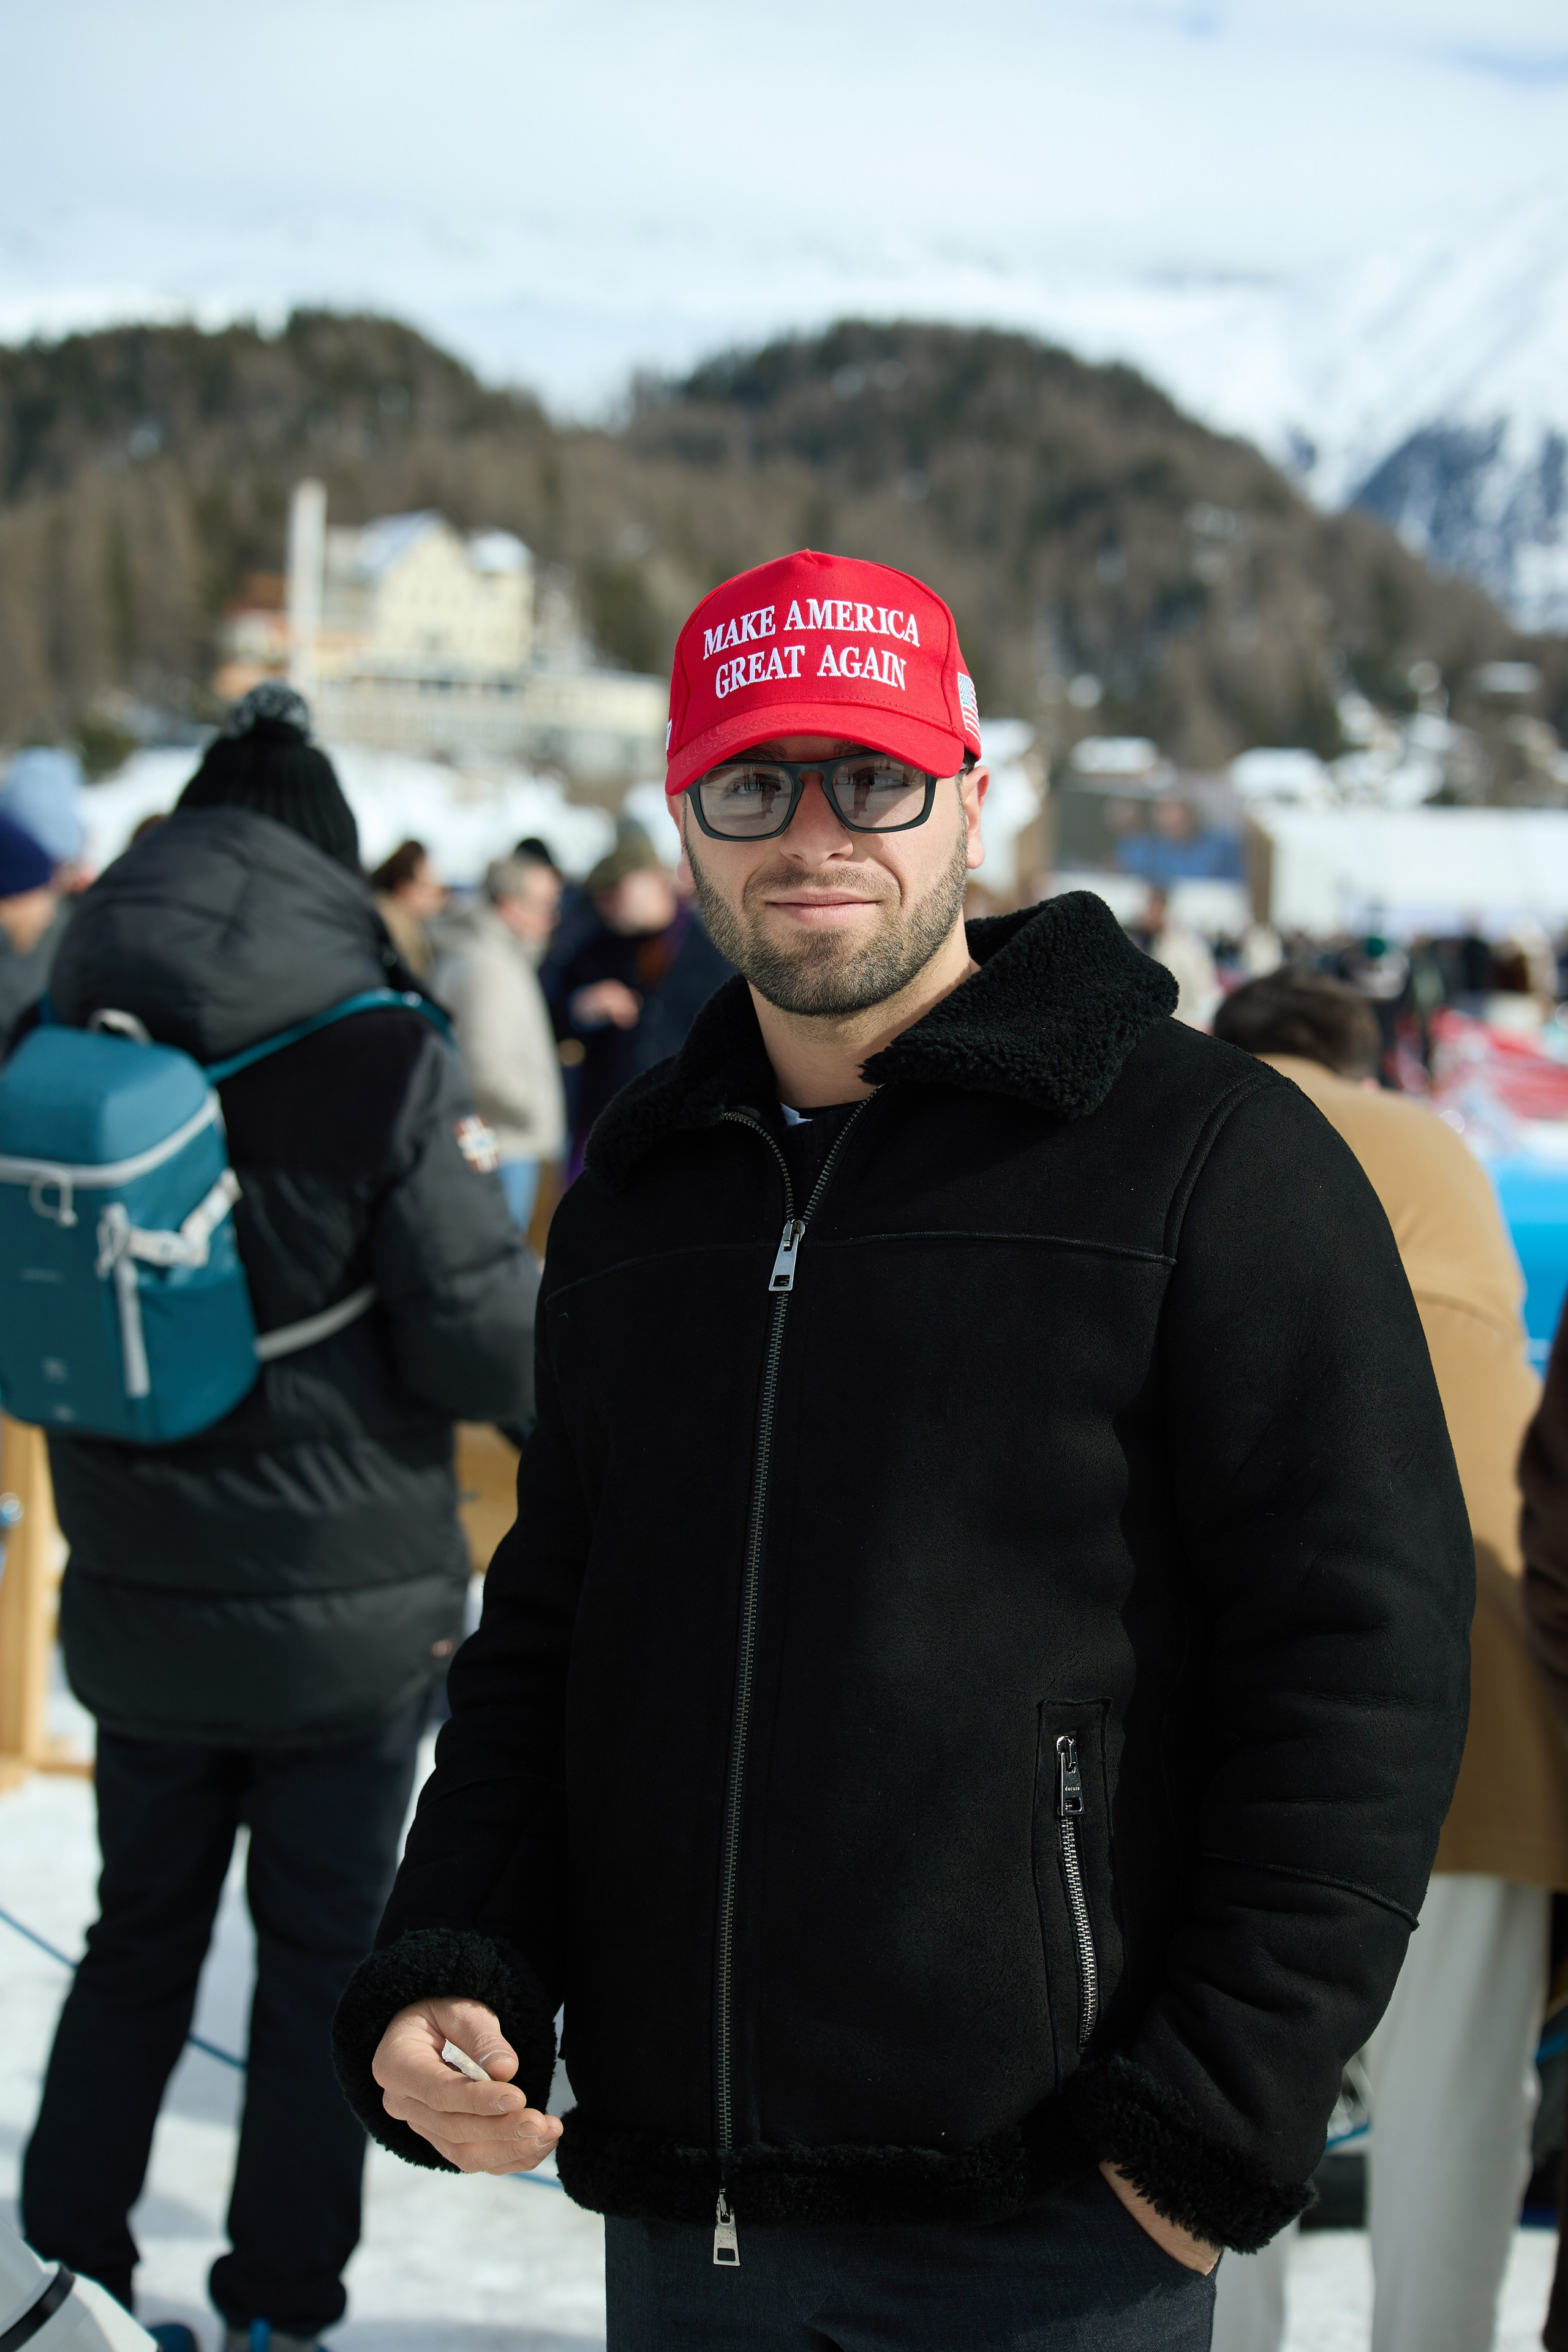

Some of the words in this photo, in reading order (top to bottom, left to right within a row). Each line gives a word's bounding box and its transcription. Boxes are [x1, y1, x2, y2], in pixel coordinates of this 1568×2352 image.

[703, 605, 775, 660] MAKE
[783, 598, 920, 647] AMERICA
[716, 645, 805, 698] GREAT
[816, 644, 907, 691] AGAIN
